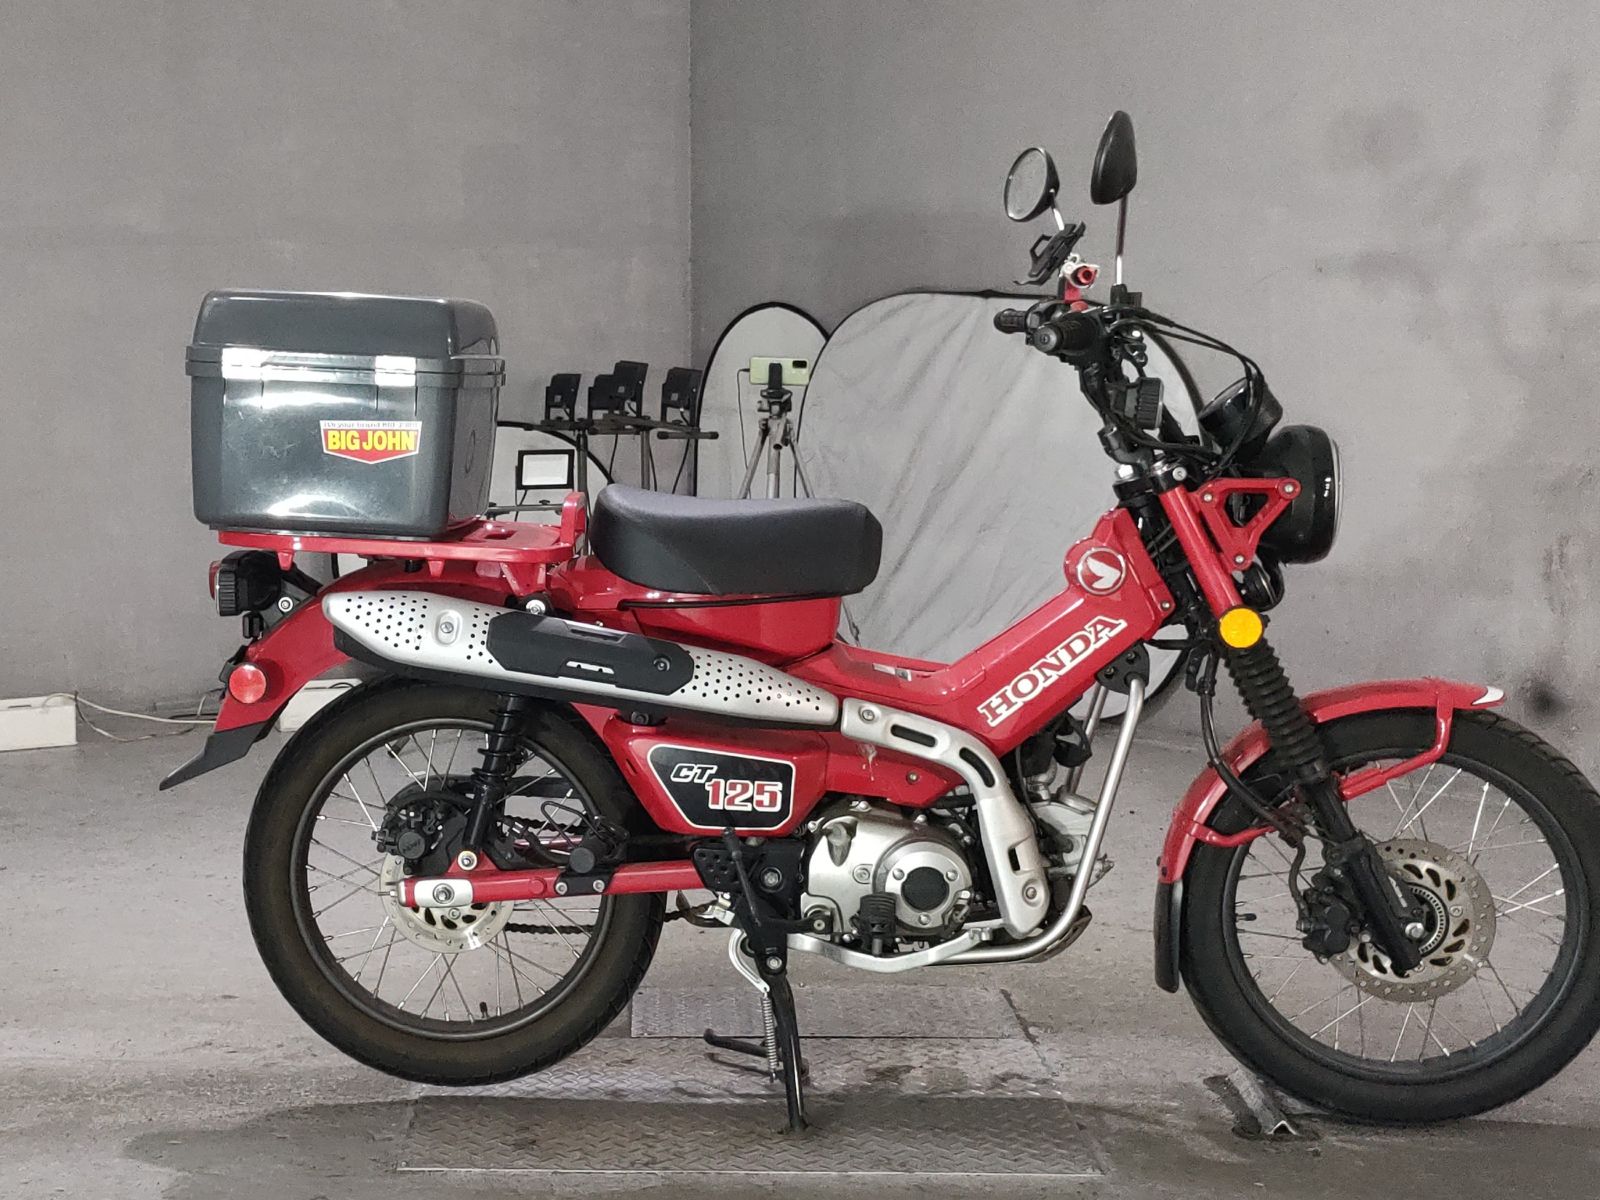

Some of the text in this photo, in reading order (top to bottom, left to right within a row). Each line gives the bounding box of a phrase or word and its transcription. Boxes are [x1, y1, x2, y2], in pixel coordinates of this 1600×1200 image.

[327, 430, 416, 451] BIG JOHN
[976, 615, 1128, 728] HONDA
[670, 763, 718, 783] CT
[705, 778, 783, 812] 125
